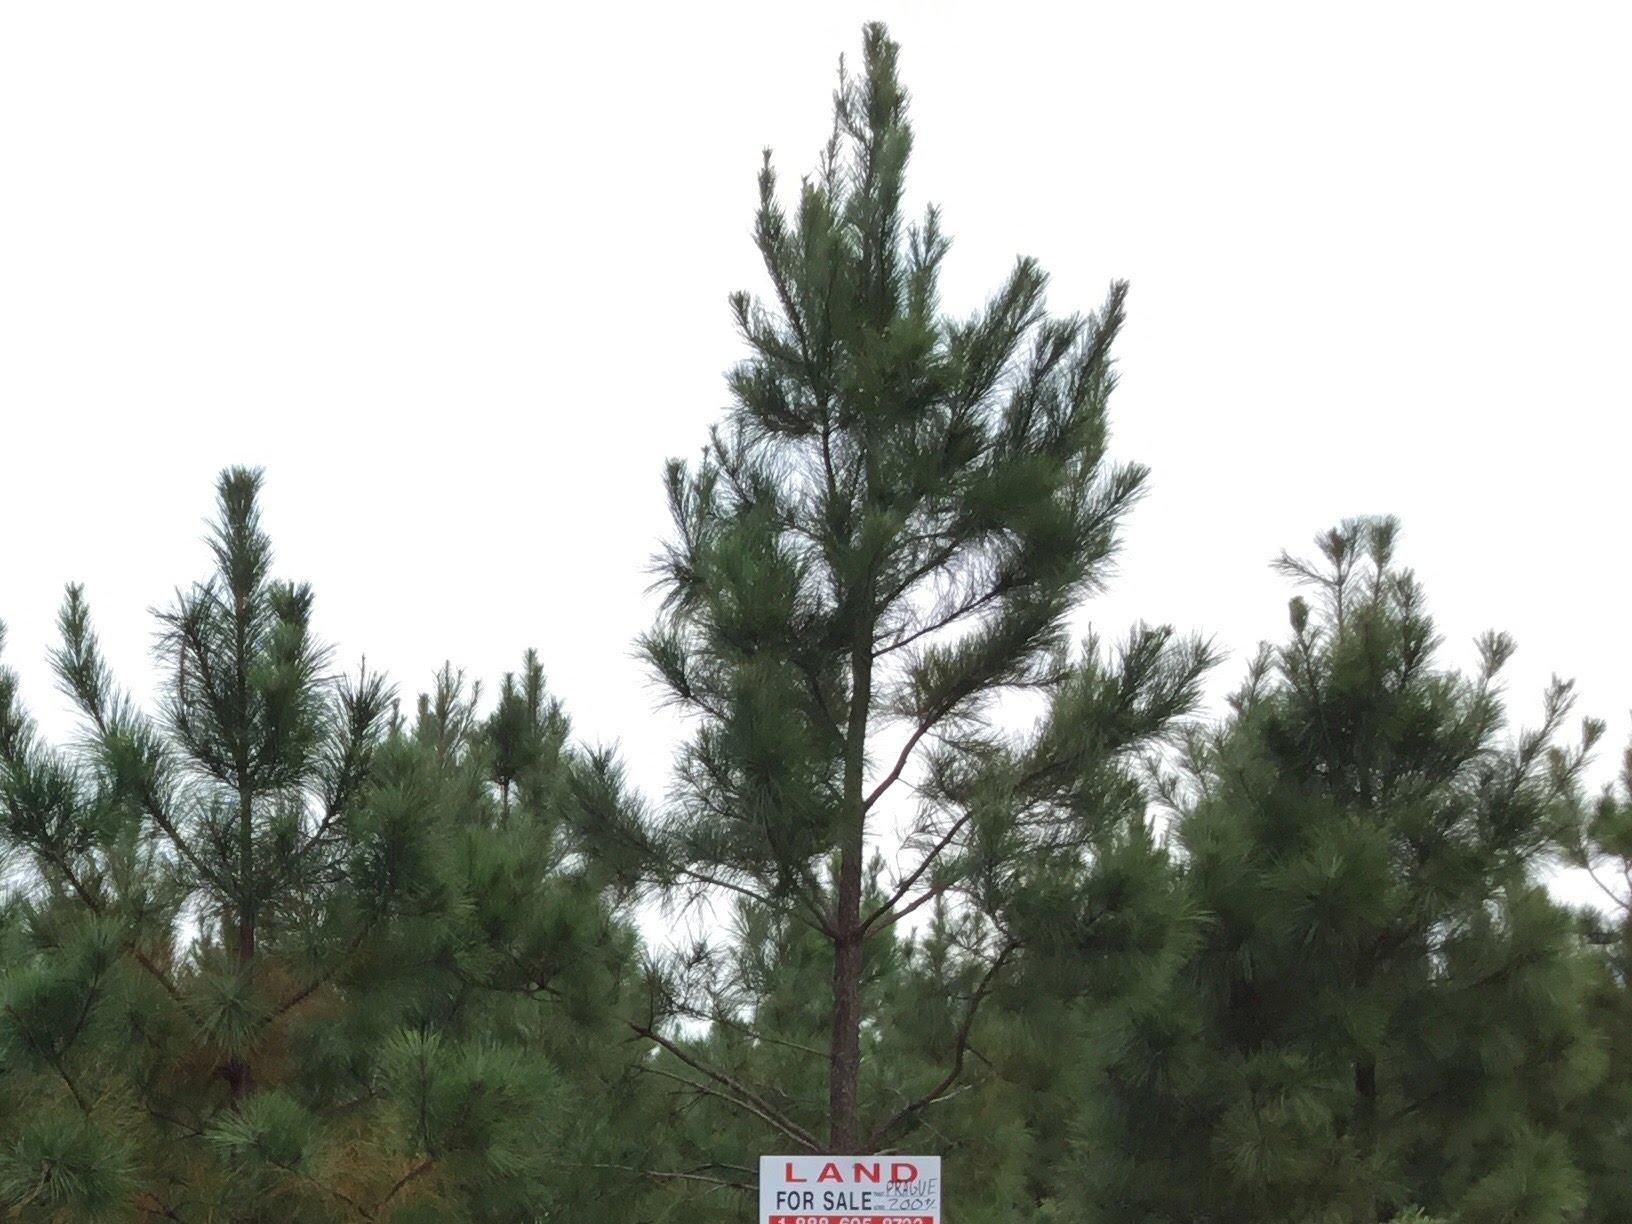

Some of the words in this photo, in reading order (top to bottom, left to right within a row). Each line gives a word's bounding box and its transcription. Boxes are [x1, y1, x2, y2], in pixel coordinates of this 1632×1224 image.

[785, 1162, 919, 1183] LAND
[886, 1178, 938, 1197] PRAGUE
[776, 1191, 814, 1210] FOR
[823, 1191, 872, 1210] SALE
